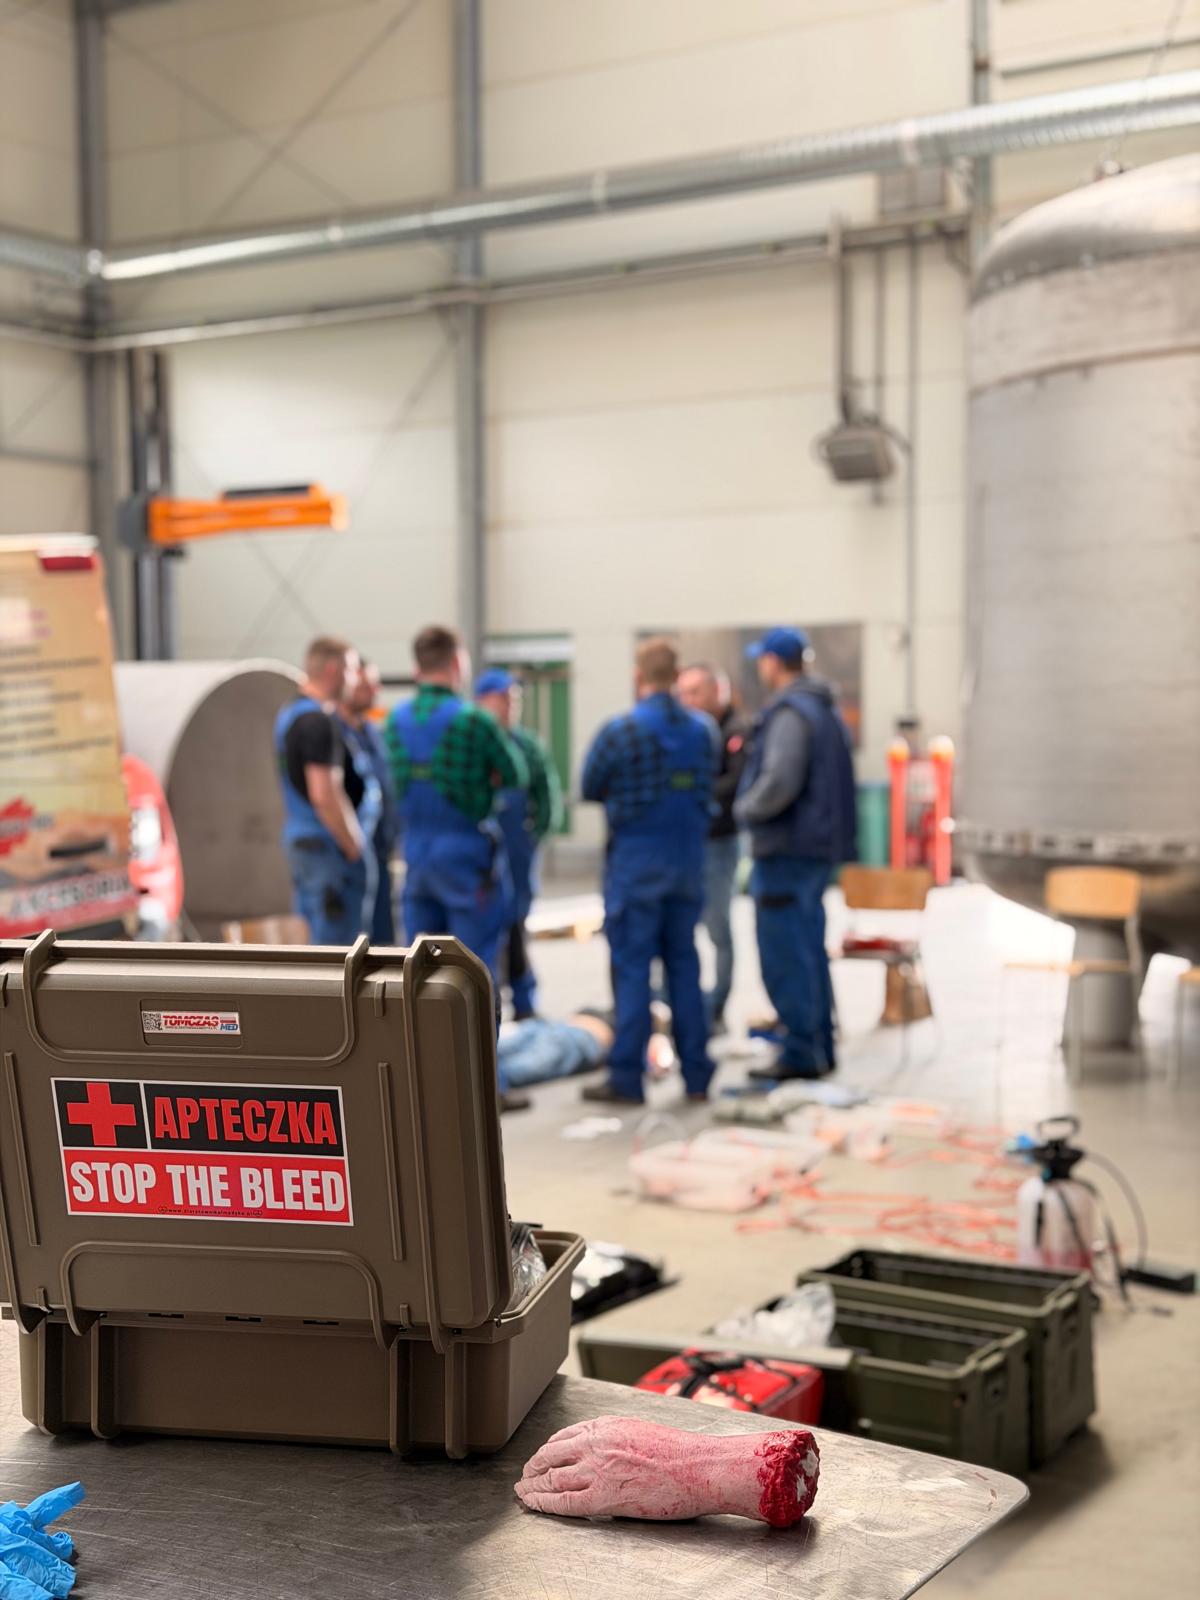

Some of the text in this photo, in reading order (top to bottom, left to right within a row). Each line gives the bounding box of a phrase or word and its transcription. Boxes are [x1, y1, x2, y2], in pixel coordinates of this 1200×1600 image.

[162, 1015, 219, 1027] TOMCZAS
[220, 1023, 238, 1031] MED
[154, 1096, 337, 1145] APTECZKA
[70, 1161, 345, 1212] STOP THE BLEED
